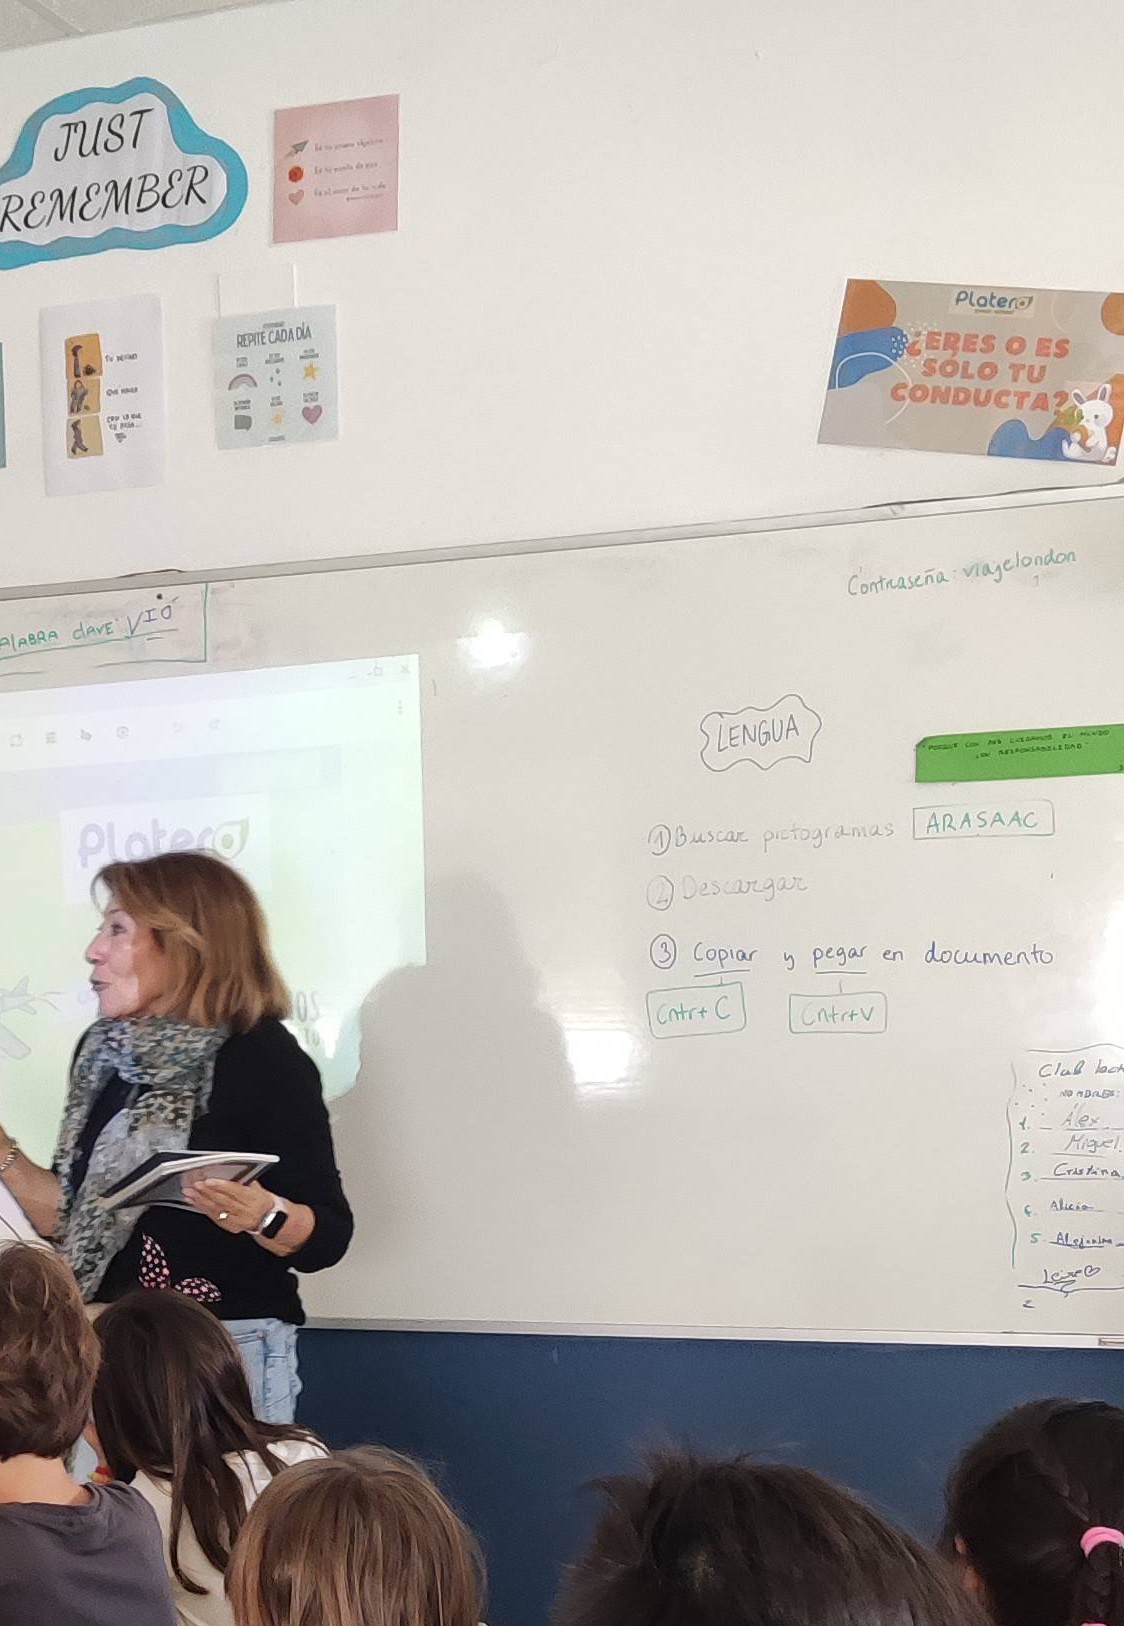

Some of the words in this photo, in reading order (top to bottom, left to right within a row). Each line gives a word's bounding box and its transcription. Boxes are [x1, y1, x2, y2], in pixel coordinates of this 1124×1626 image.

[53, 107, 155, 163] JUST
[955, 290, 1034, 311] Platero
[236, 331, 267, 348] REPITE
[268, 328, 294, 345] CADA
[295, 320, 313, 341] DÍA
[906, 330, 997, 358] ¿ERES
[1005, 335, 1027, 356] O
[1035, 337, 1071, 359] ES
[1008, 362, 1047, 384] TU
[890, 381, 1070, 416] CONDUCTA?
[717, 713, 800, 753] LENGUA
[926, 810, 1039, 835] ARASAAC
[675, 824, 749, 848] Buscar
[763, 821, 895, 854] pictogramas
[682, 874, 810, 903] Descargar
[693, 945, 759, 970] Copiar
[783, 951, 795, 971] y
[812, 945, 868, 970] pegar
[882, 947, 905, 963] en
[924, 940, 1055, 965] documento
